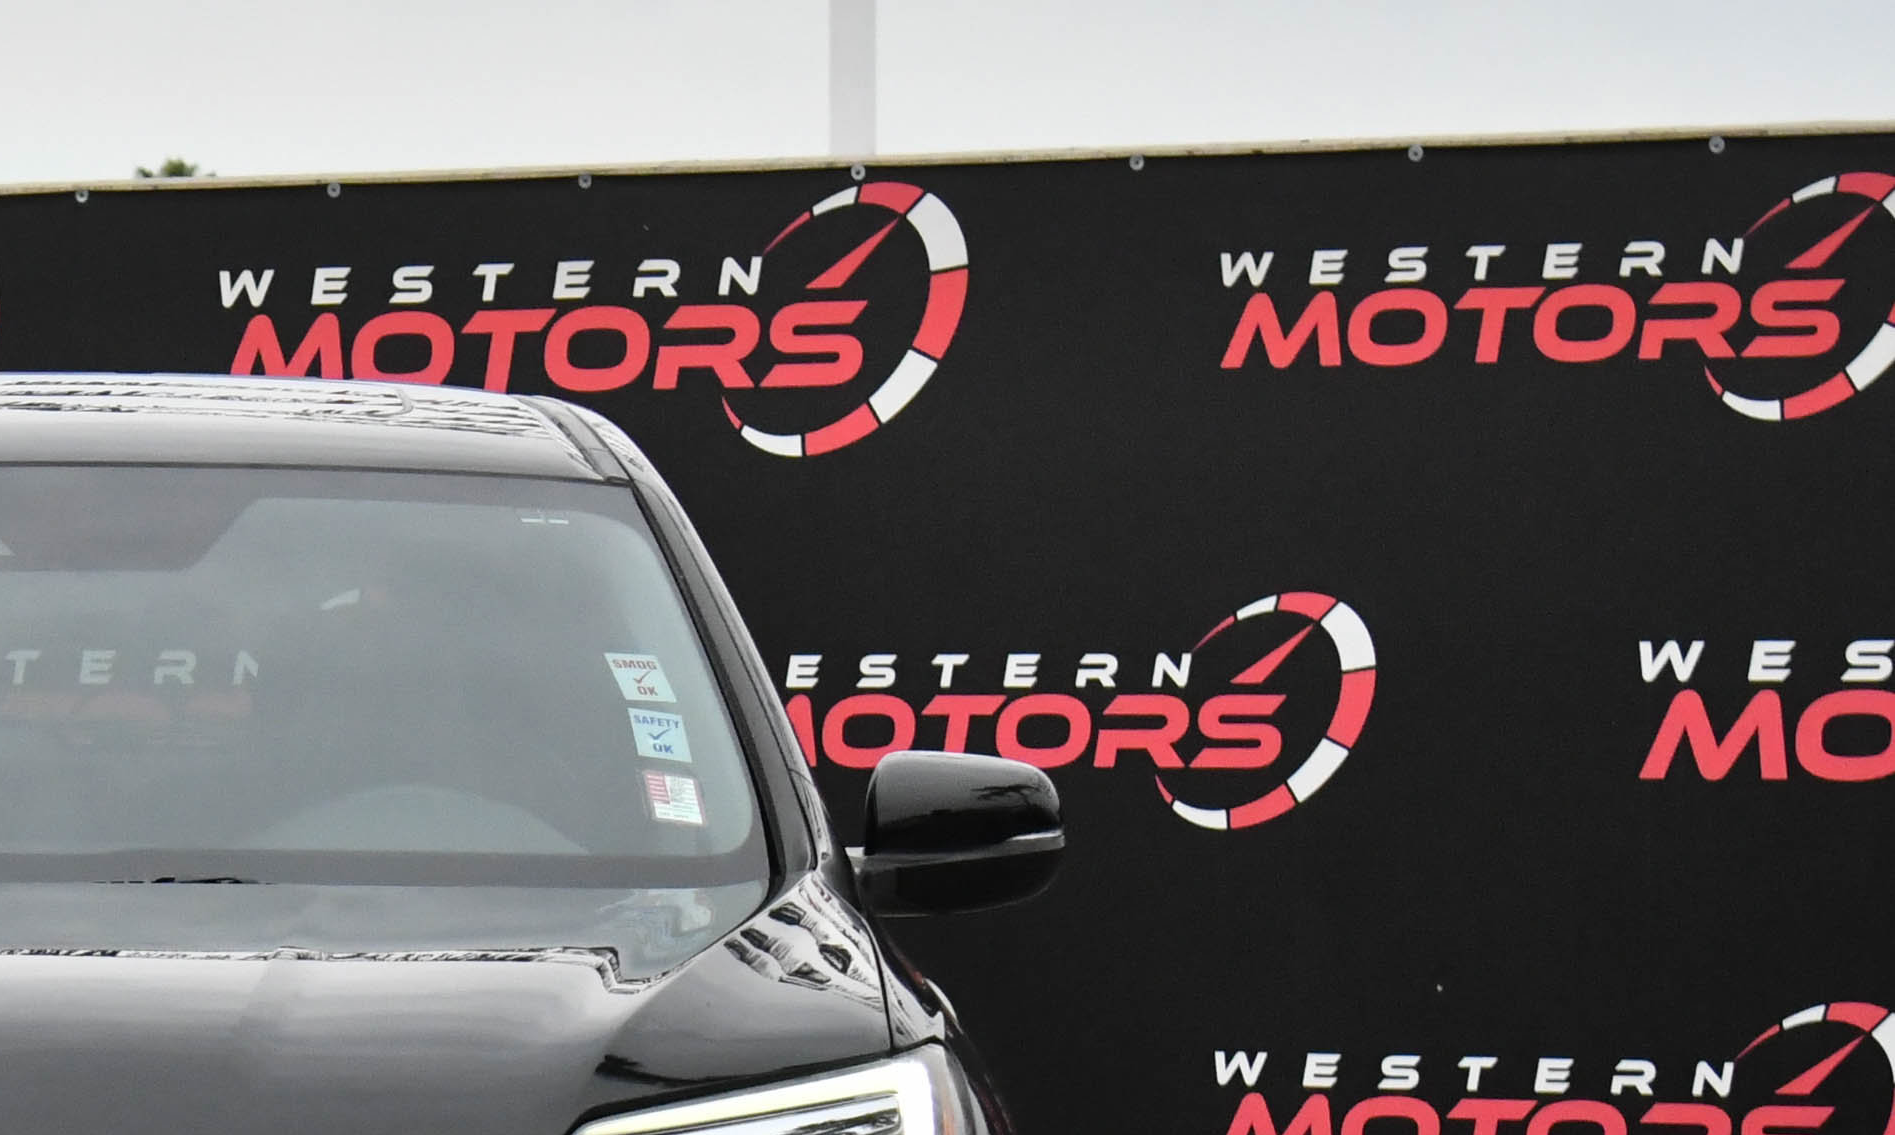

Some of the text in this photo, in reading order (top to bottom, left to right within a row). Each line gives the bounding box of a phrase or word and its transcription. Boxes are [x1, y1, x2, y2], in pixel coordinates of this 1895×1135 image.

[219, 256, 763, 308] WESTERN
[1220, 237, 1744, 288] WESTERN
[230, 300, 868, 394] MOTORS
[1221, 278, 1845, 370] MOTORS
[611, 658, 658, 671] SMOG
[637, 686, 659, 697] OK
[633, 714, 680, 729] SAFETY
[652, 743, 675, 755] OK
[1214, 1050, 1735, 1097] WESTERN
